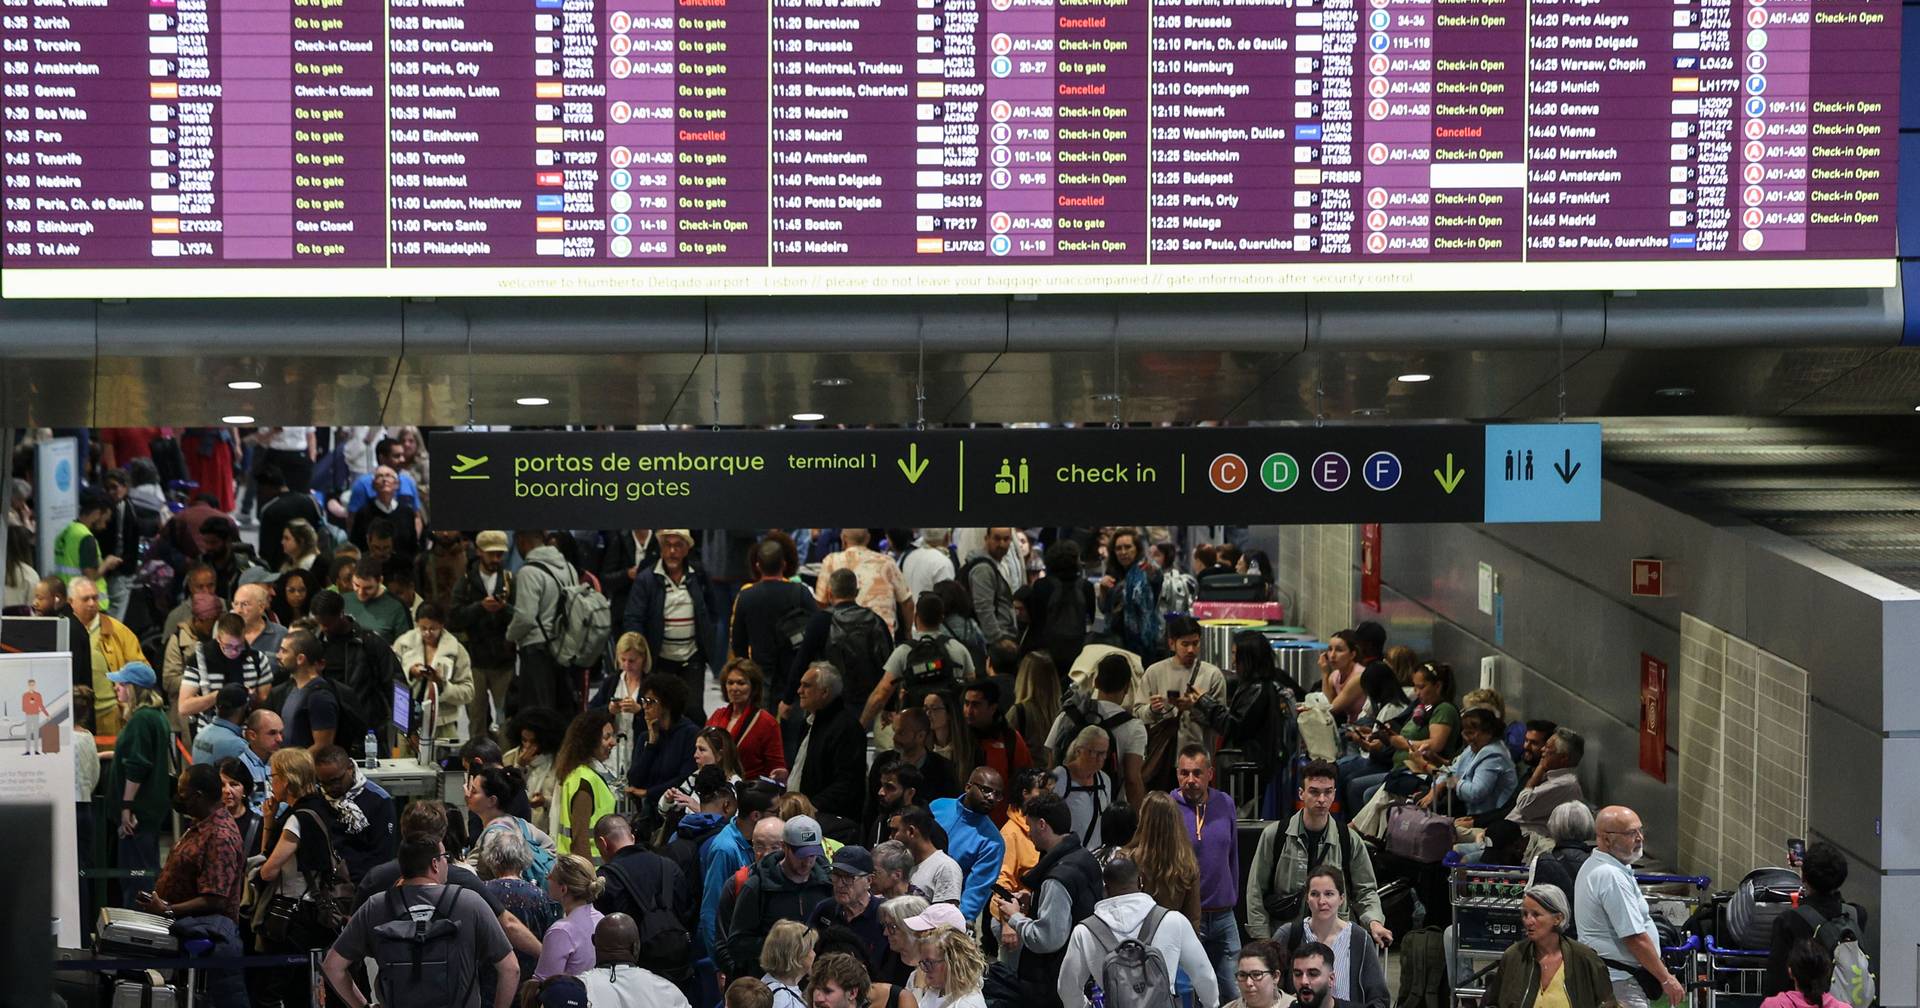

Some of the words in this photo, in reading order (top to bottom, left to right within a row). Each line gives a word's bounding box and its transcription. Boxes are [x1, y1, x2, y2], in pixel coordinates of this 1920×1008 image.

[422, 17, 464, 29] Brasilia
[633, 18, 673, 29] A01-A30
[773, 17, 801, 29] 11:20
[805, 17, 859, 29] Barcelona
[1060, 17, 1106, 28] Cancelled
[1185, 16, 1231, 28] Brussels
[1562, 14, 1591, 26] Porto
[1593, 14, 1628, 28] Alegre
[1769, 12, 1809, 23] A01-A30
[1816, 12, 1857, 23] Check-in
[1859, 12, 1883, 24] Open
[422, 40, 449, 52] Gran
[451, 40, 493, 52] Canaria
[805, 39, 852, 51] Brussels
[1153, 38, 1180, 50] 12:10
[1184, 38, 1215, 51] Paris,
[1218, 38, 1235, 50] Ch.
[1238, 38, 1251, 50] de
[1253, 38, 1287, 50] Gaulle
[1562, 36, 1592, 48] Ponta
[1595, 36, 1638, 51] Delgada
[423, 62, 454, 75] Paris,
[456, 62, 479, 76] Orly
[805, 62, 856, 75] Montreal,
[858, 62, 903, 74] Trudeau
[1184, 60, 1233, 75] Hamburg
[1561, 58, 1606, 71] Warsaw,
[1609, 58, 1646, 72] Chopin
[1700, 57, 1733, 69] LO426
[423, 85, 466, 98] London,
[468, 85, 499, 97] Luton
[564, 85, 605, 96] EZY2460
[805, 84, 855, 97] Brussels,
[858, 84, 908, 96] Charleroi
[945, 84, 984, 96] FR3609
[1059, 84, 1105, 95] Cancelled
[1184, 83, 1249, 97] Copenhagen
[1561, 81, 1599, 92] Munich
[1700, 80, 1739, 91] LH1779
[423, 107, 456, 119] Miami
[805, 107, 848, 119] Madeira
[1184, 105, 1225, 117] Newark
[1561, 103, 1599, 115] Geneva
[423, 130, 478, 142] Eindhoven
[564, 130, 604, 141] FR1140
[679, 130, 726, 141] Cancelled
[805, 129, 842, 141] Madrid
[1017, 129, 1049, 139] 97-100
[1183, 128, 1248, 142] Washington,
[1251, 127, 1285, 139] Dulles
[1436, 127, 1482, 137] Cancelled
[1560, 126, 1595, 137] Vienna
[423, 152, 465, 164] Toronto
[563, 152, 597, 164] TP257
[773, 152, 801, 163] 11:40
[804, 152, 867, 163] Amsterdam
[1015, 151, 1051, 162] 101-104
[1183, 150, 1239, 161] Stockholm
[1560, 148, 1617, 159] Marrakech
[423, 175, 467, 186] Istanbul
[805, 174, 836, 185] Ponta
[838, 174, 882, 188] Delgada
[944, 173, 982, 185] S43127
[1183, 172, 1233, 186] Budapest
[1559, 170, 1621, 181] Amsterdam
[391, 197, 420, 209] 11:00
[423, 197, 466, 210] London,
[469, 197, 521, 209] Heathrow
[640, 197, 667, 208] 77-80
[773, 196, 801, 208] 11:40
[805, 196, 836, 208] Ponta
[838, 196, 881, 210] Delgada
[944, 196, 982, 207] S43126
[1059, 196, 1104, 206] Cancelled
[1183, 194, 1213, 207] Paris,
[1216, 194, 1238, 208] Orly
[1560, 192, 1609, 204] Frankfurt
[296, 221, 319, 231] Gate
[320, 221, 353, 231] Closed
[424, 220, 453, 231] Porto
[455, 220, 487, 231] Santo
[564, 220, 605, 230] EJU6735
[679, 220, 721, 230] Check-in
[724, 220, 748, 232] Open
[805, 219, 842, 230] Boston
[944, 218, 977, 229] TP217
[1183, 217, 1221, 231] Malaga
[1559, 214, 1596, 226] Madrid
[805, 241, 848, 252] Madeira
[944, 241, 984, 251] EJU7623
[1058, 240, 1100, 250] Check-in
[1102, 240, 1126, 252] Open
[1152, 239, 1179, 250] 12:30
[1183, 239, 1202, 249] Sao
[1205, 239, 1237, 251] Paulo,
[1239, 238, 1292, 249] Guarulhos
[1559, 236, 1578, 247] Sao
[1580, 236, 1612, 248] Paulo,
[1615, 236, 1668, 247] Guarulhos
[392, 242, 420, 254] 11:05
[424, 242, 490, 256] Philadelphia
[498, 278, 557, 288] welcome
[561, 278, 574, 288] to
[578, 278, 644, 288] Humberto
[648, 277, 701, 290] Delgado
[705, 277, 750, 290] airport
[764, 277, 807, 288] Lisbon
[825, 276, 867, 290] please
[873, 276, 888, 287] do
[892, 276, 912, 287] not
[916, 276, 951, 287] leave
[954, 278, 982, 290] your
[987, 276, 1042, 290] baggage
[1046, 275, 1148, 289] unaccompanied
[1166, 275, 1194, 288] gate
[1198, 274, 1273, 285] information
[1278, 274, 1307, 285] after
[1312, 273, 1363, 287] security
[1367, 273, 1414, 284] control
[515, 454, 593, 476] portas
[601, 453, 630, 471] de
[639, 452, 764, 475] embarque
[788, 454, 864, 468] terminal
[870, 454, 876, 467] 1
[1057, 464, 1128, 482] check
[1137, 463, 1156, 481] in
[1221, 463, 1236, 483] C
[1273, 462, 1288, 482] D
[1325, 462, 1338, 481] E
[1377, 461, 1389, 481] F
[516, 478, 618, 501] boarding
[627, 479, 690, 501] gates
